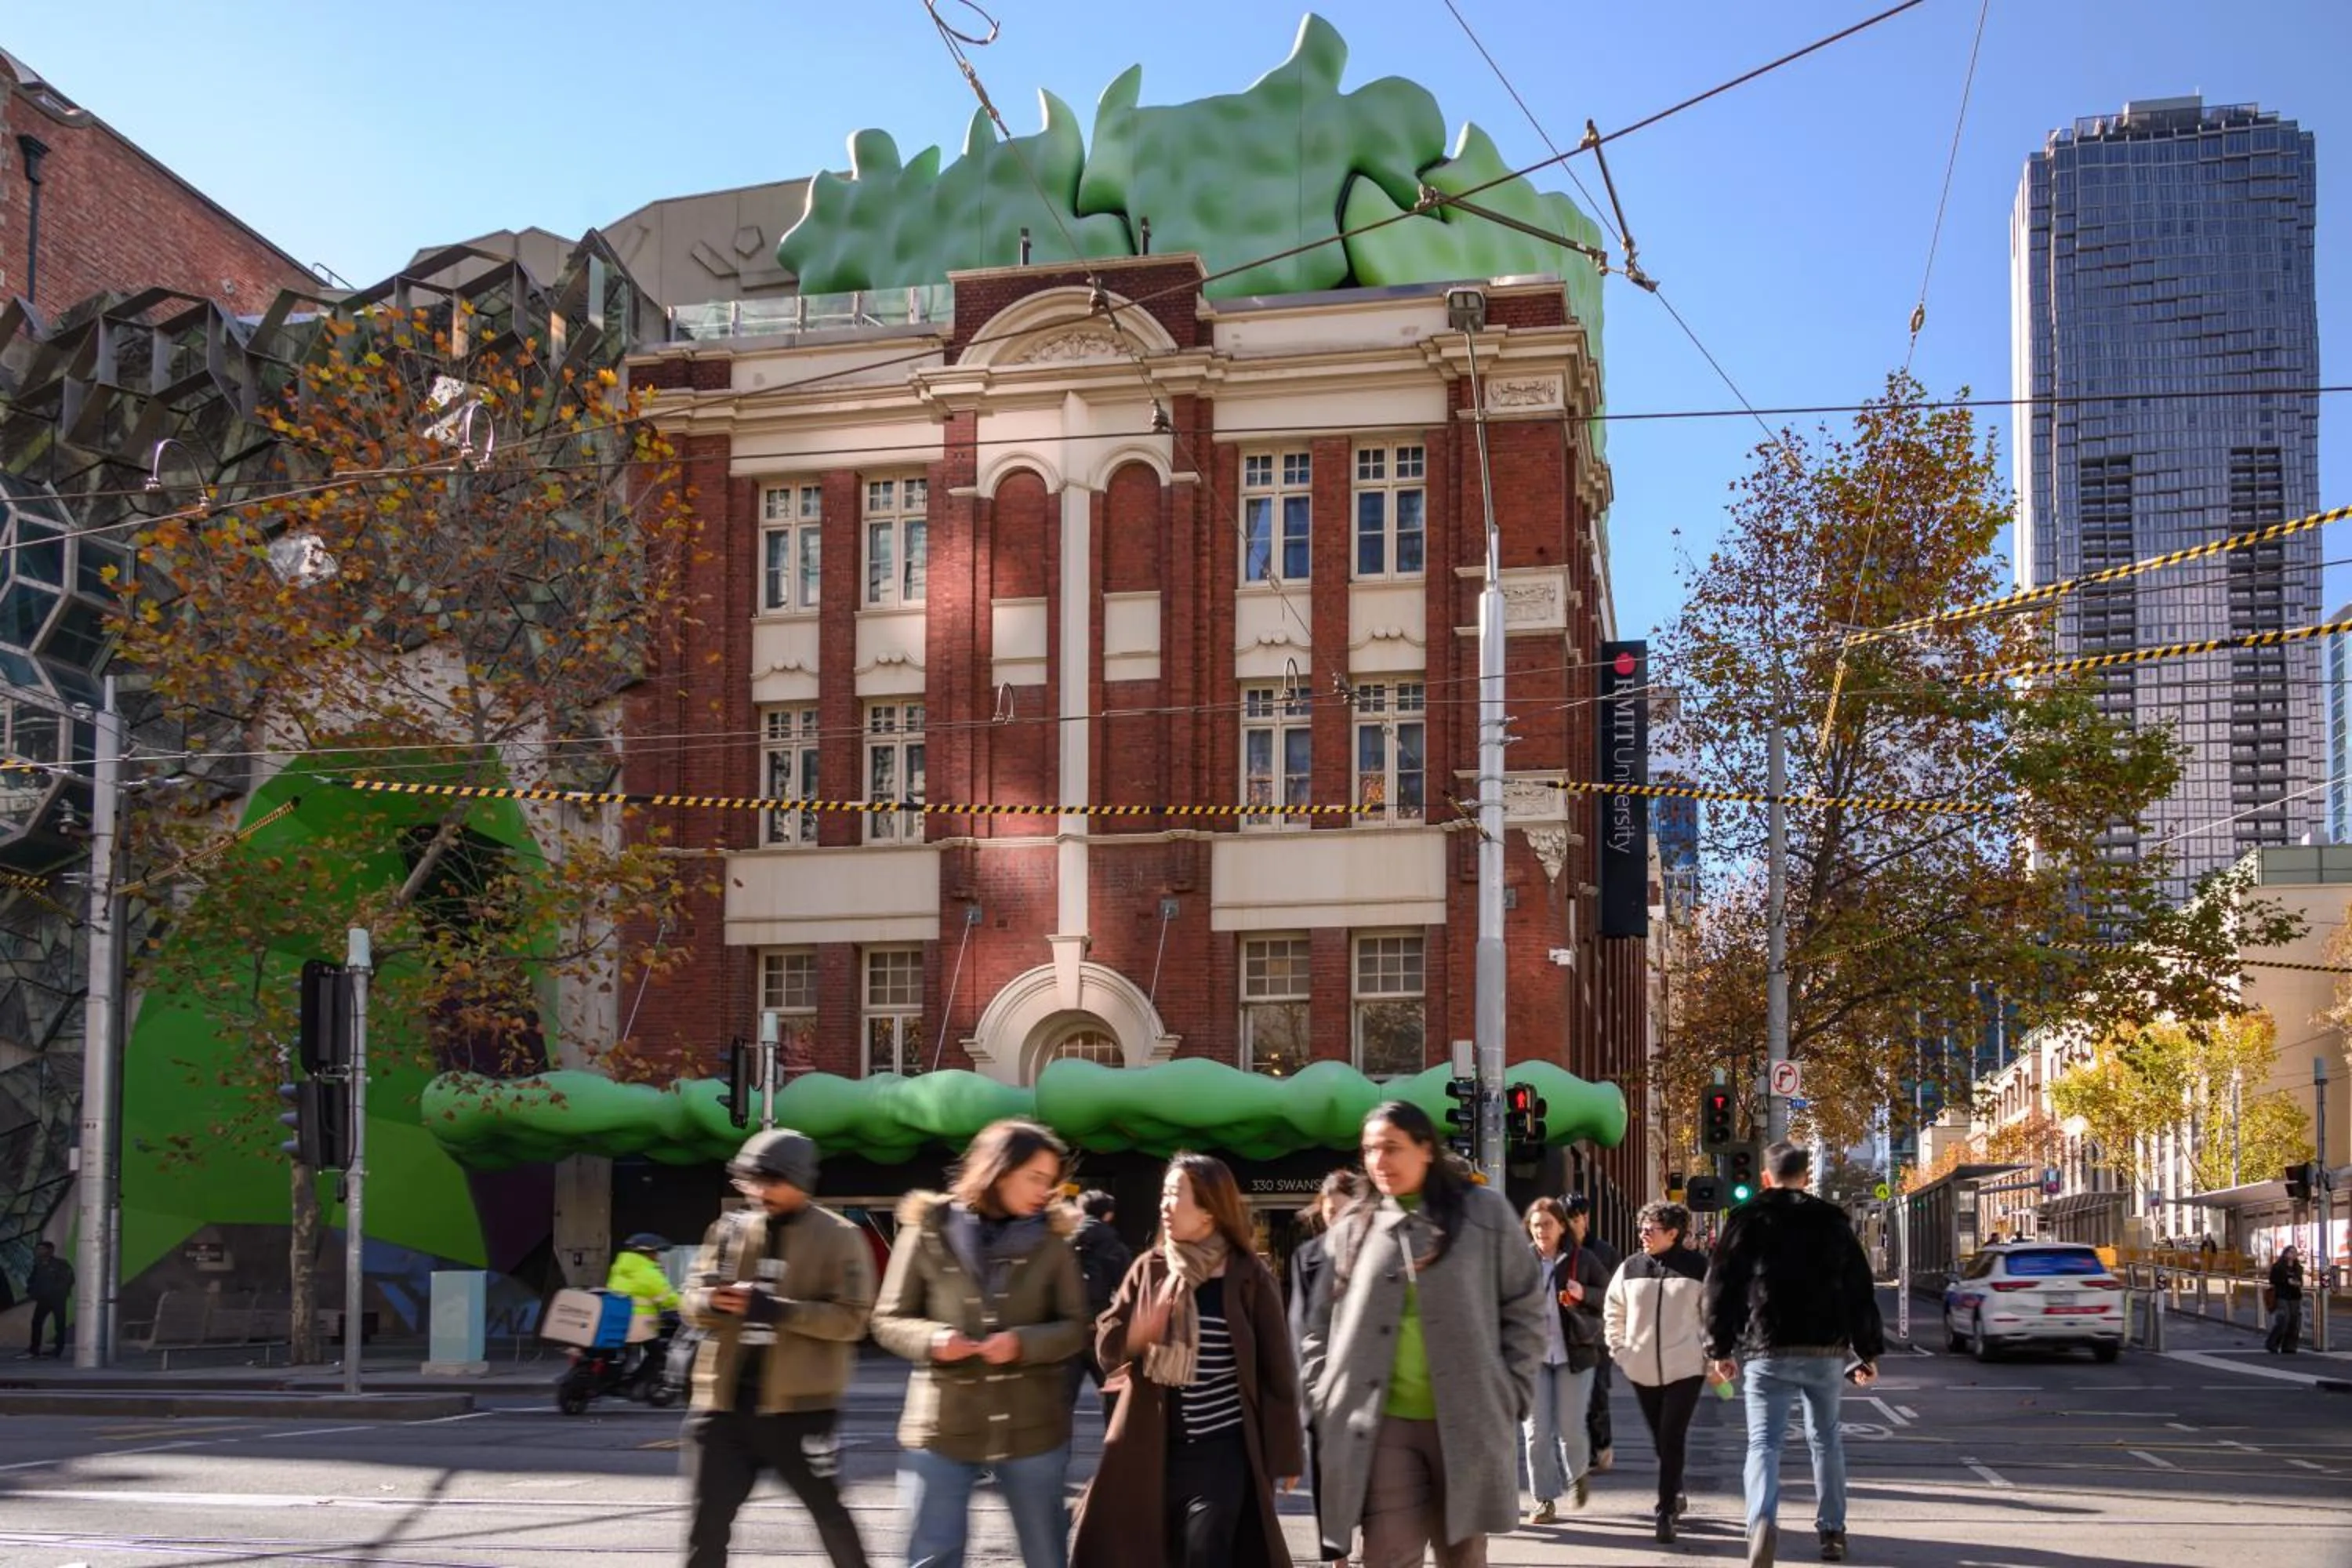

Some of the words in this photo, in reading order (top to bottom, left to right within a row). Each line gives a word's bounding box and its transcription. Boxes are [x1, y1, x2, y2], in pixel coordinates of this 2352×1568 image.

[1614, 677, 1635, 746] RMIT
[1606, 746, 1635, 854] Uniersity
[1252, 1179, 1274, 1191] 330
